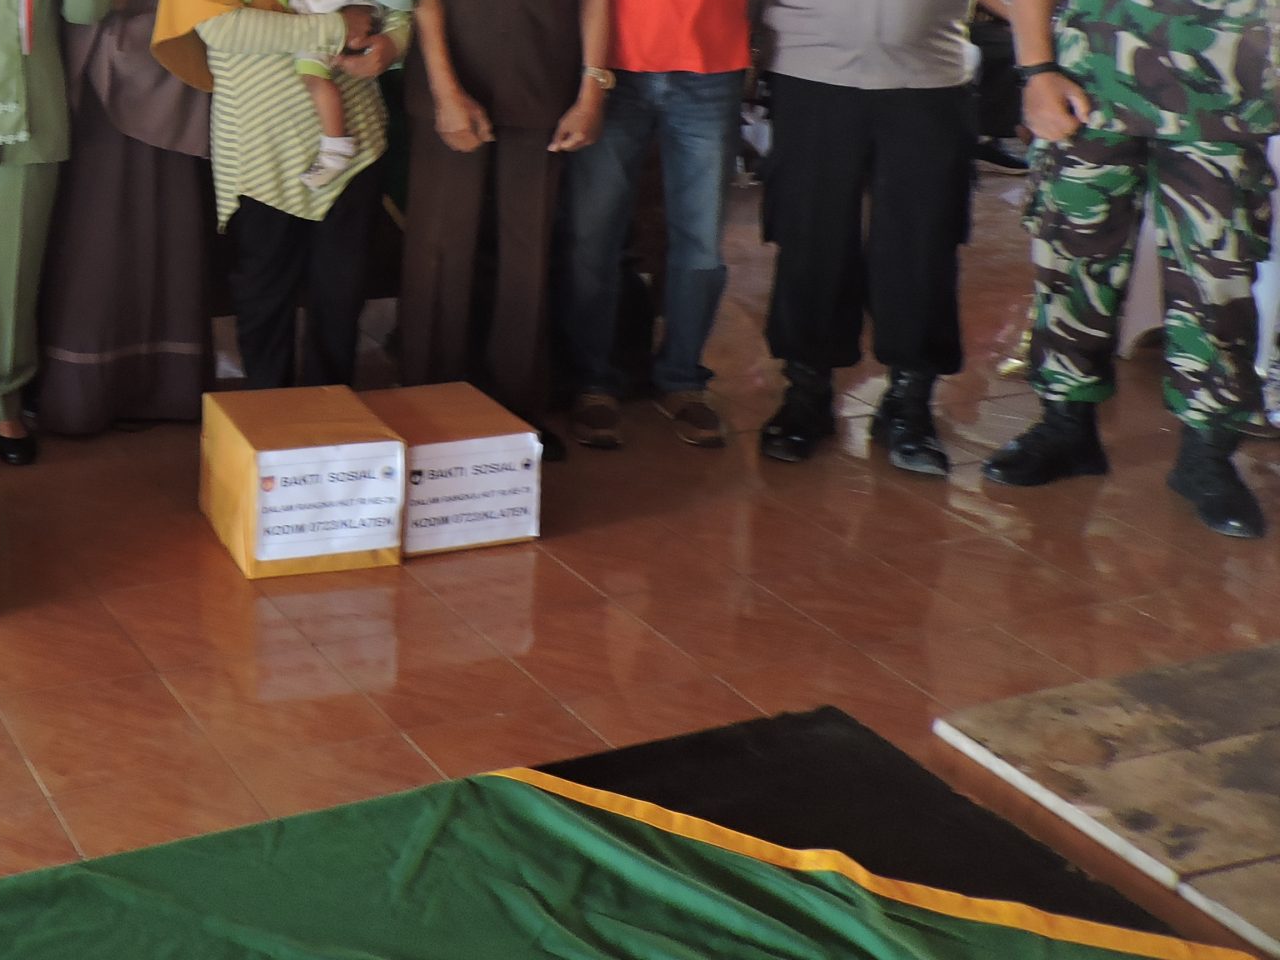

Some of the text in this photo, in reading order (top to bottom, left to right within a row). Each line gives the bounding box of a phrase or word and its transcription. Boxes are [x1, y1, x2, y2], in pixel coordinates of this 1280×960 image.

[471, 461, 517, 476] SOSIAL
[280, 468, 377, 488] BAKTI SOSIAL
[263, 524, 305, 537] KODIM
